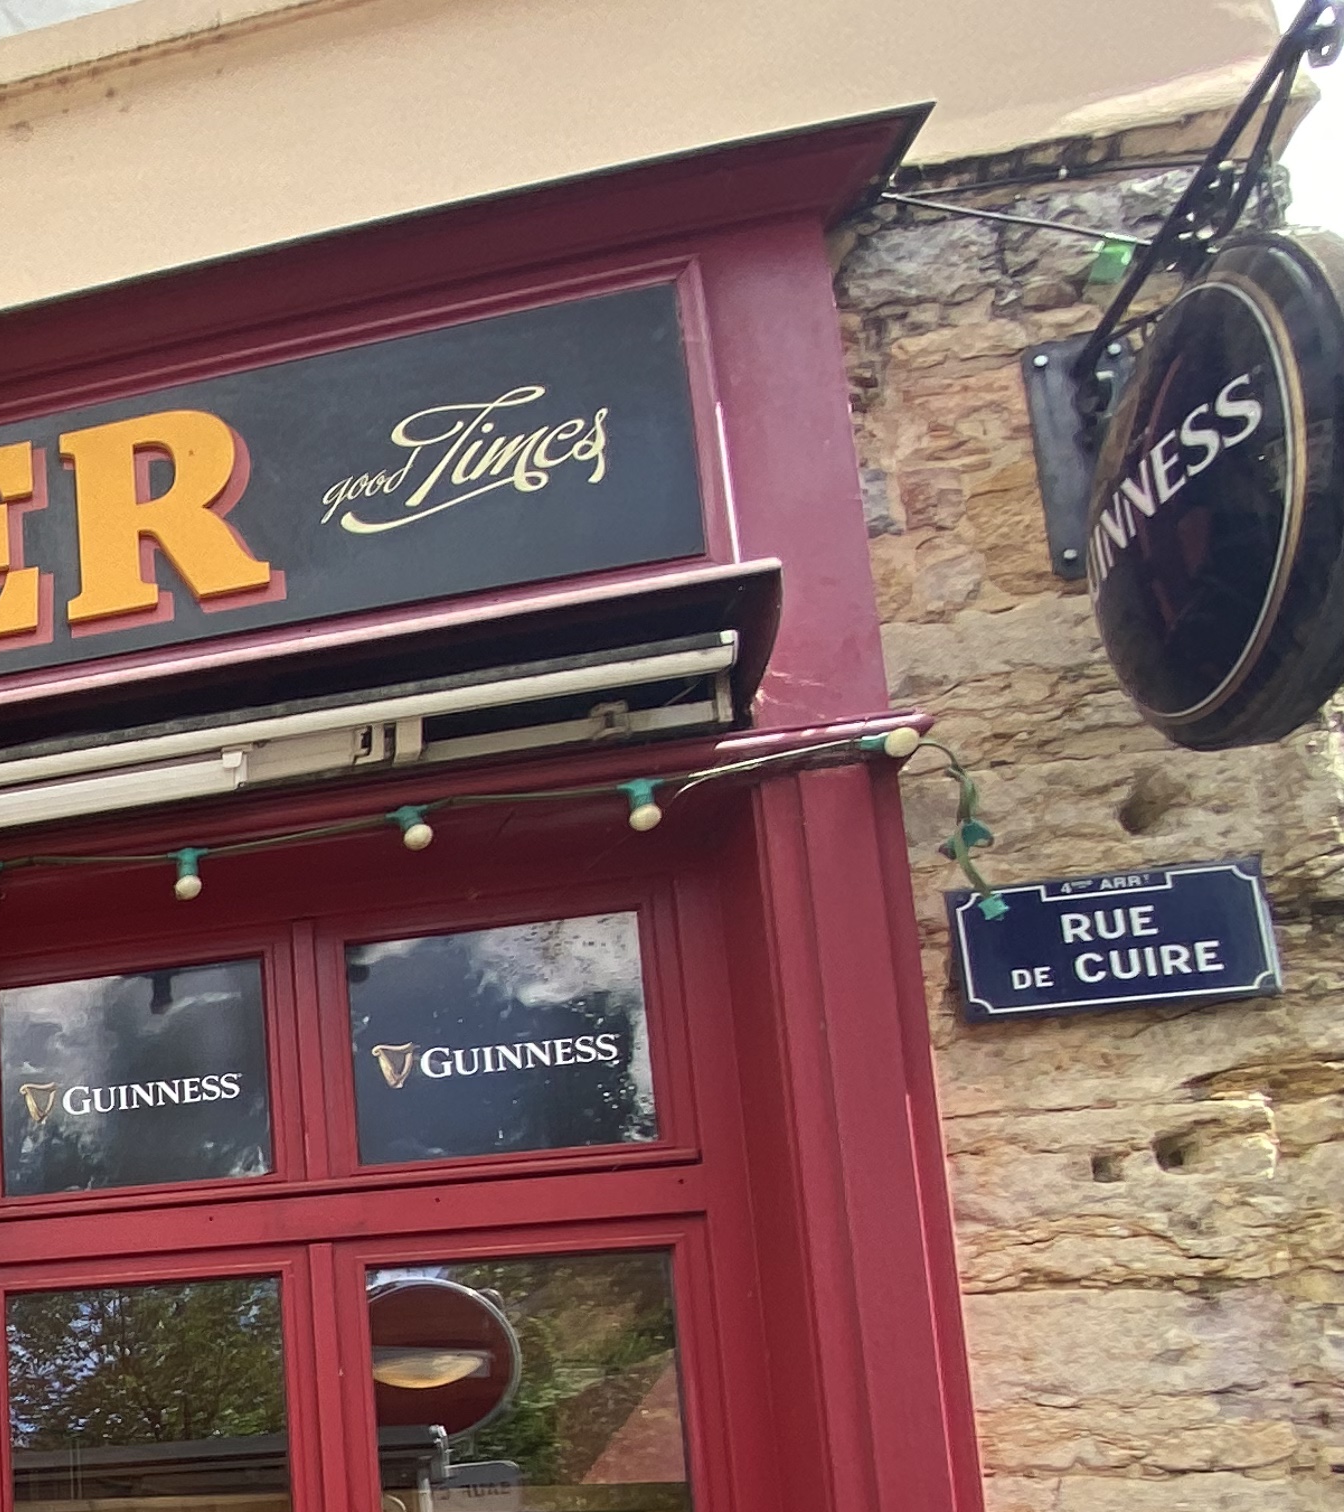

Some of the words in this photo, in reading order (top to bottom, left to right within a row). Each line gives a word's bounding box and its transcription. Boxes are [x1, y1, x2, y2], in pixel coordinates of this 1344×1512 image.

[340, 384, 606, 533] Times
[320, 446, 421, 525] good
[1060, 905, 1159, 943] RUE
[1011, 966, 1054, 990] DE
[1074, 940, 1225, 984] CUIRE
[419, 1033, 619, 1079] GUINNESS
[62, 1073, 241, 1115] GUINNESS
